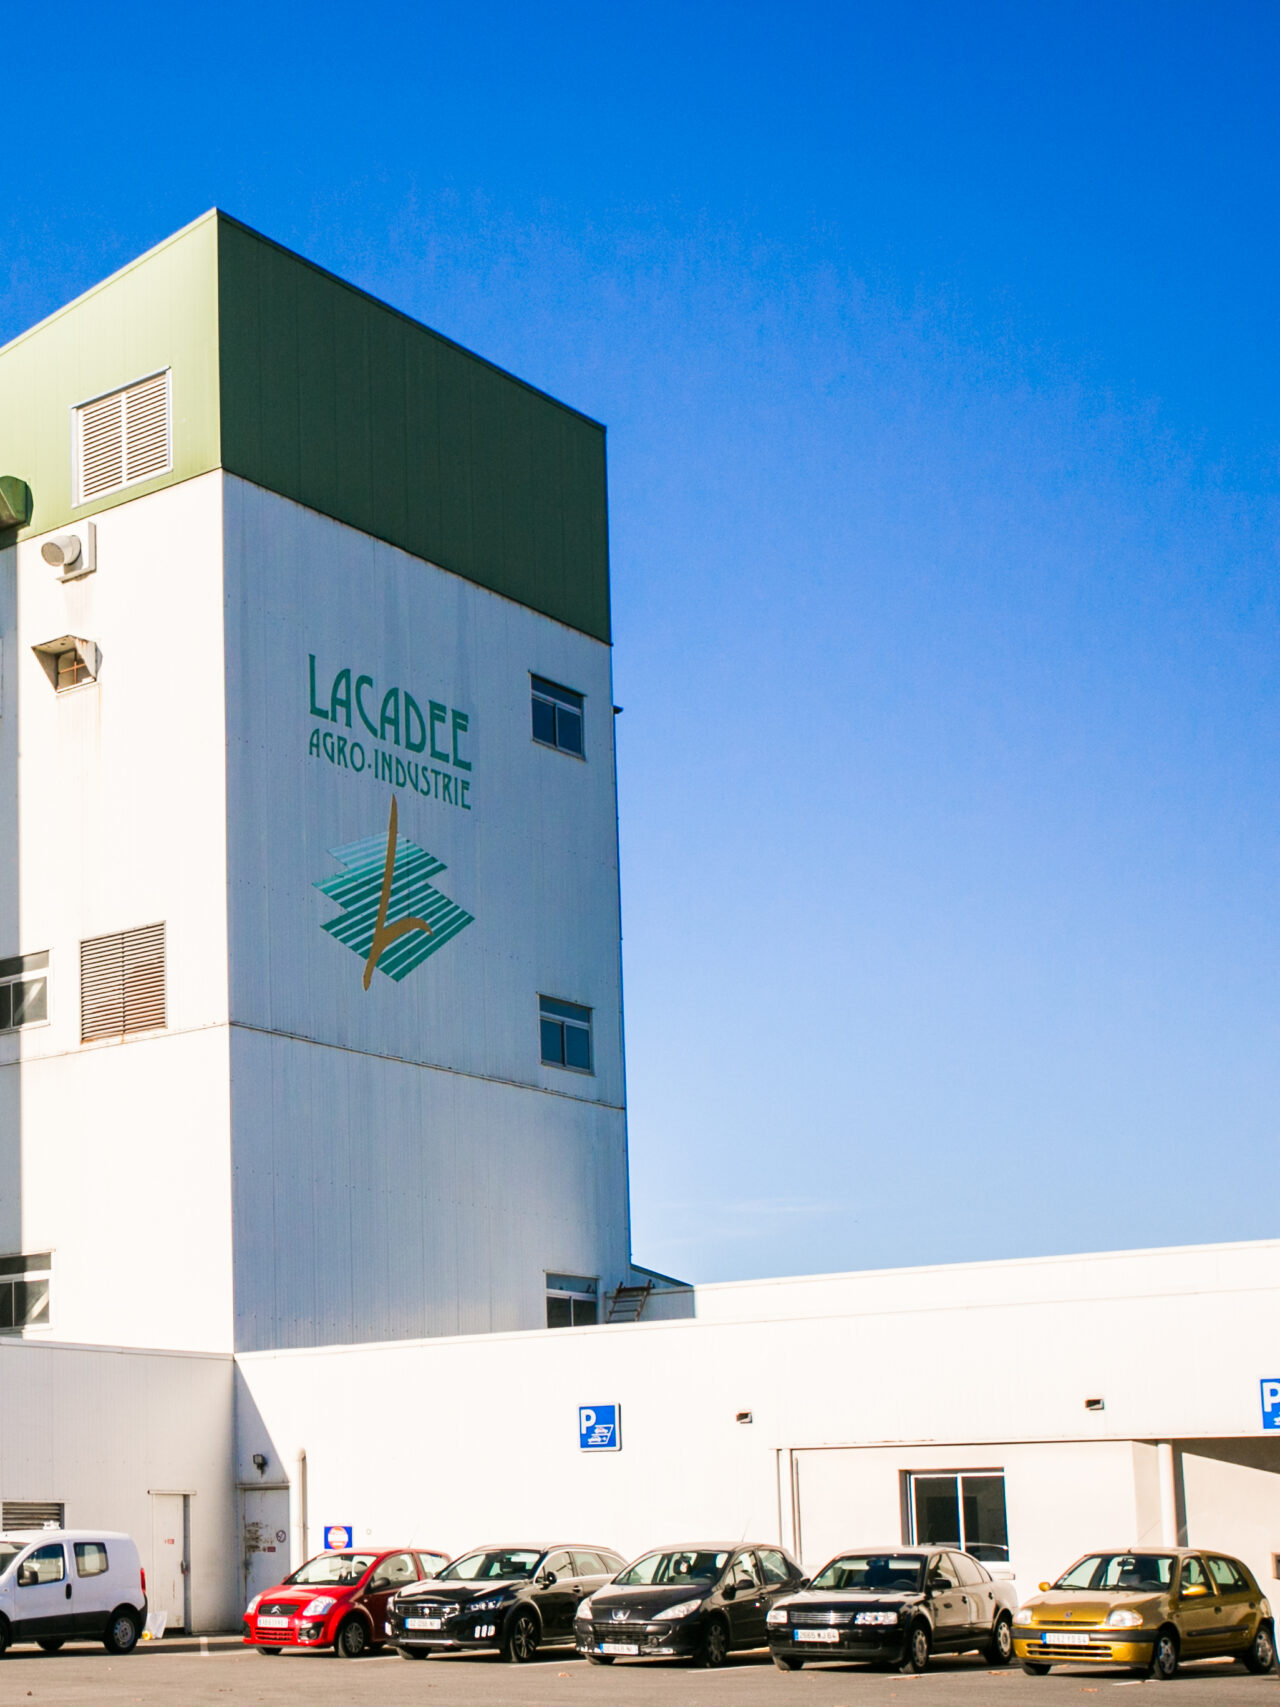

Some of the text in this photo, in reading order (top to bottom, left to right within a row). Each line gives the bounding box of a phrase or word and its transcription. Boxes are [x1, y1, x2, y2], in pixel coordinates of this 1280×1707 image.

[308, 653, 472, 772] LACADEE
[1262, 1382, 1280, 1412] P
[581, 1408, 597, 1435] P
